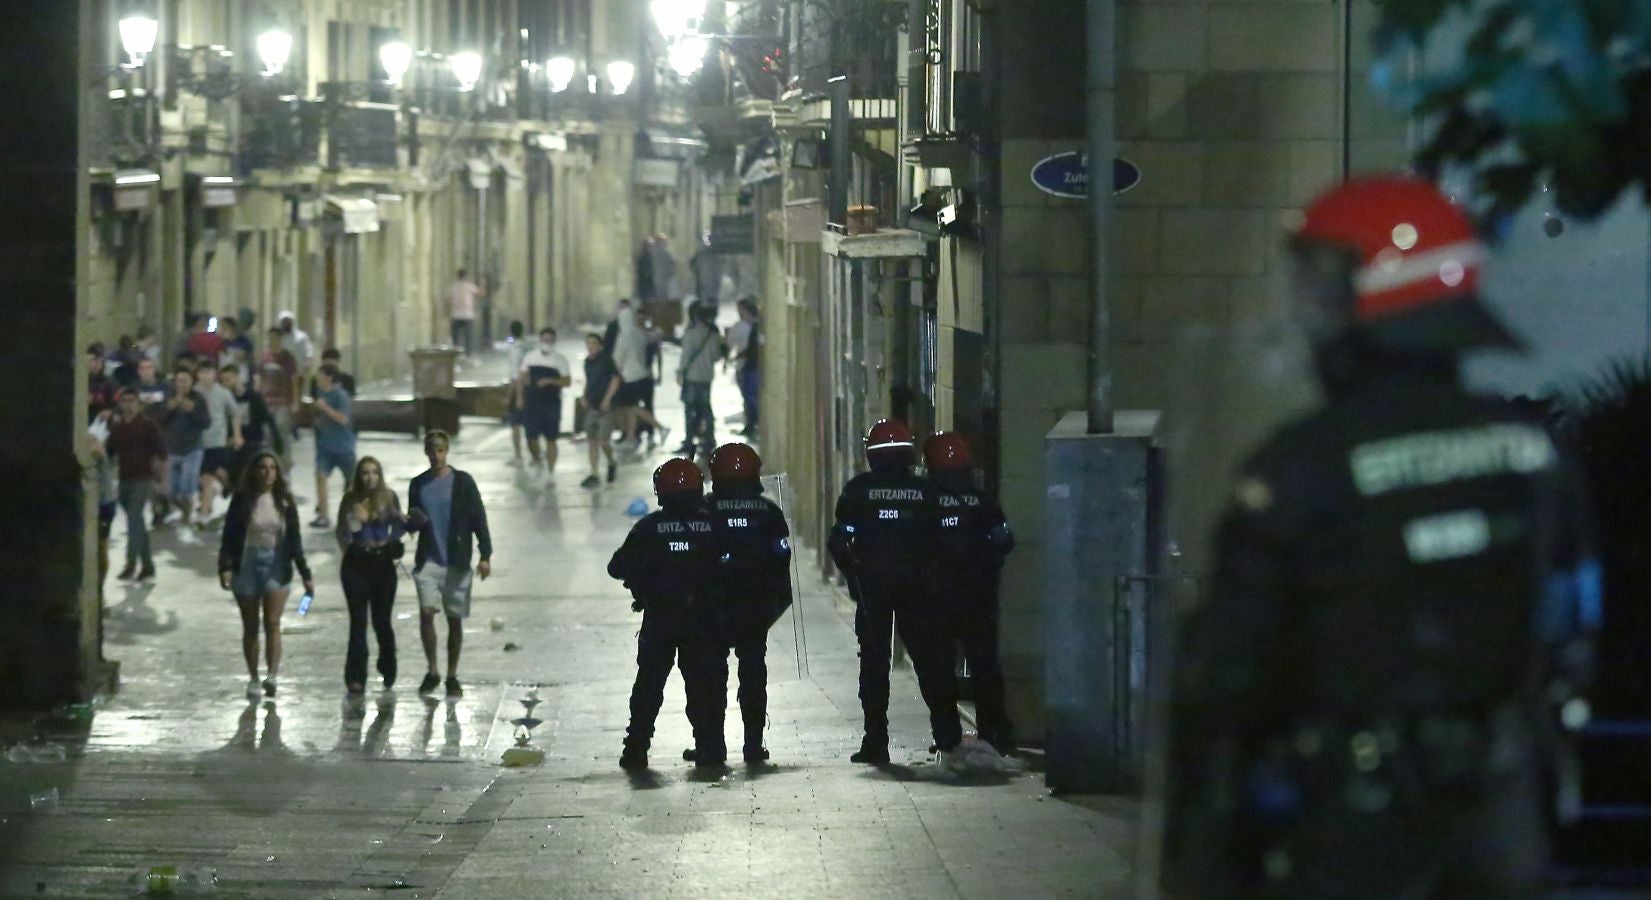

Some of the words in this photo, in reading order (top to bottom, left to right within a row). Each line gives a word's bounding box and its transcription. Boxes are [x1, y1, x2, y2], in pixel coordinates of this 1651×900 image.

[868, 488, 923, 500] ERTZAINTZA
[717, 499, 768, 510] ERTZAINTZA
[657, 522, 711, 533] ERTZNTZA
[727, 518, 748, 528] E1R5
[669, 541, 689, 551] T2R4
